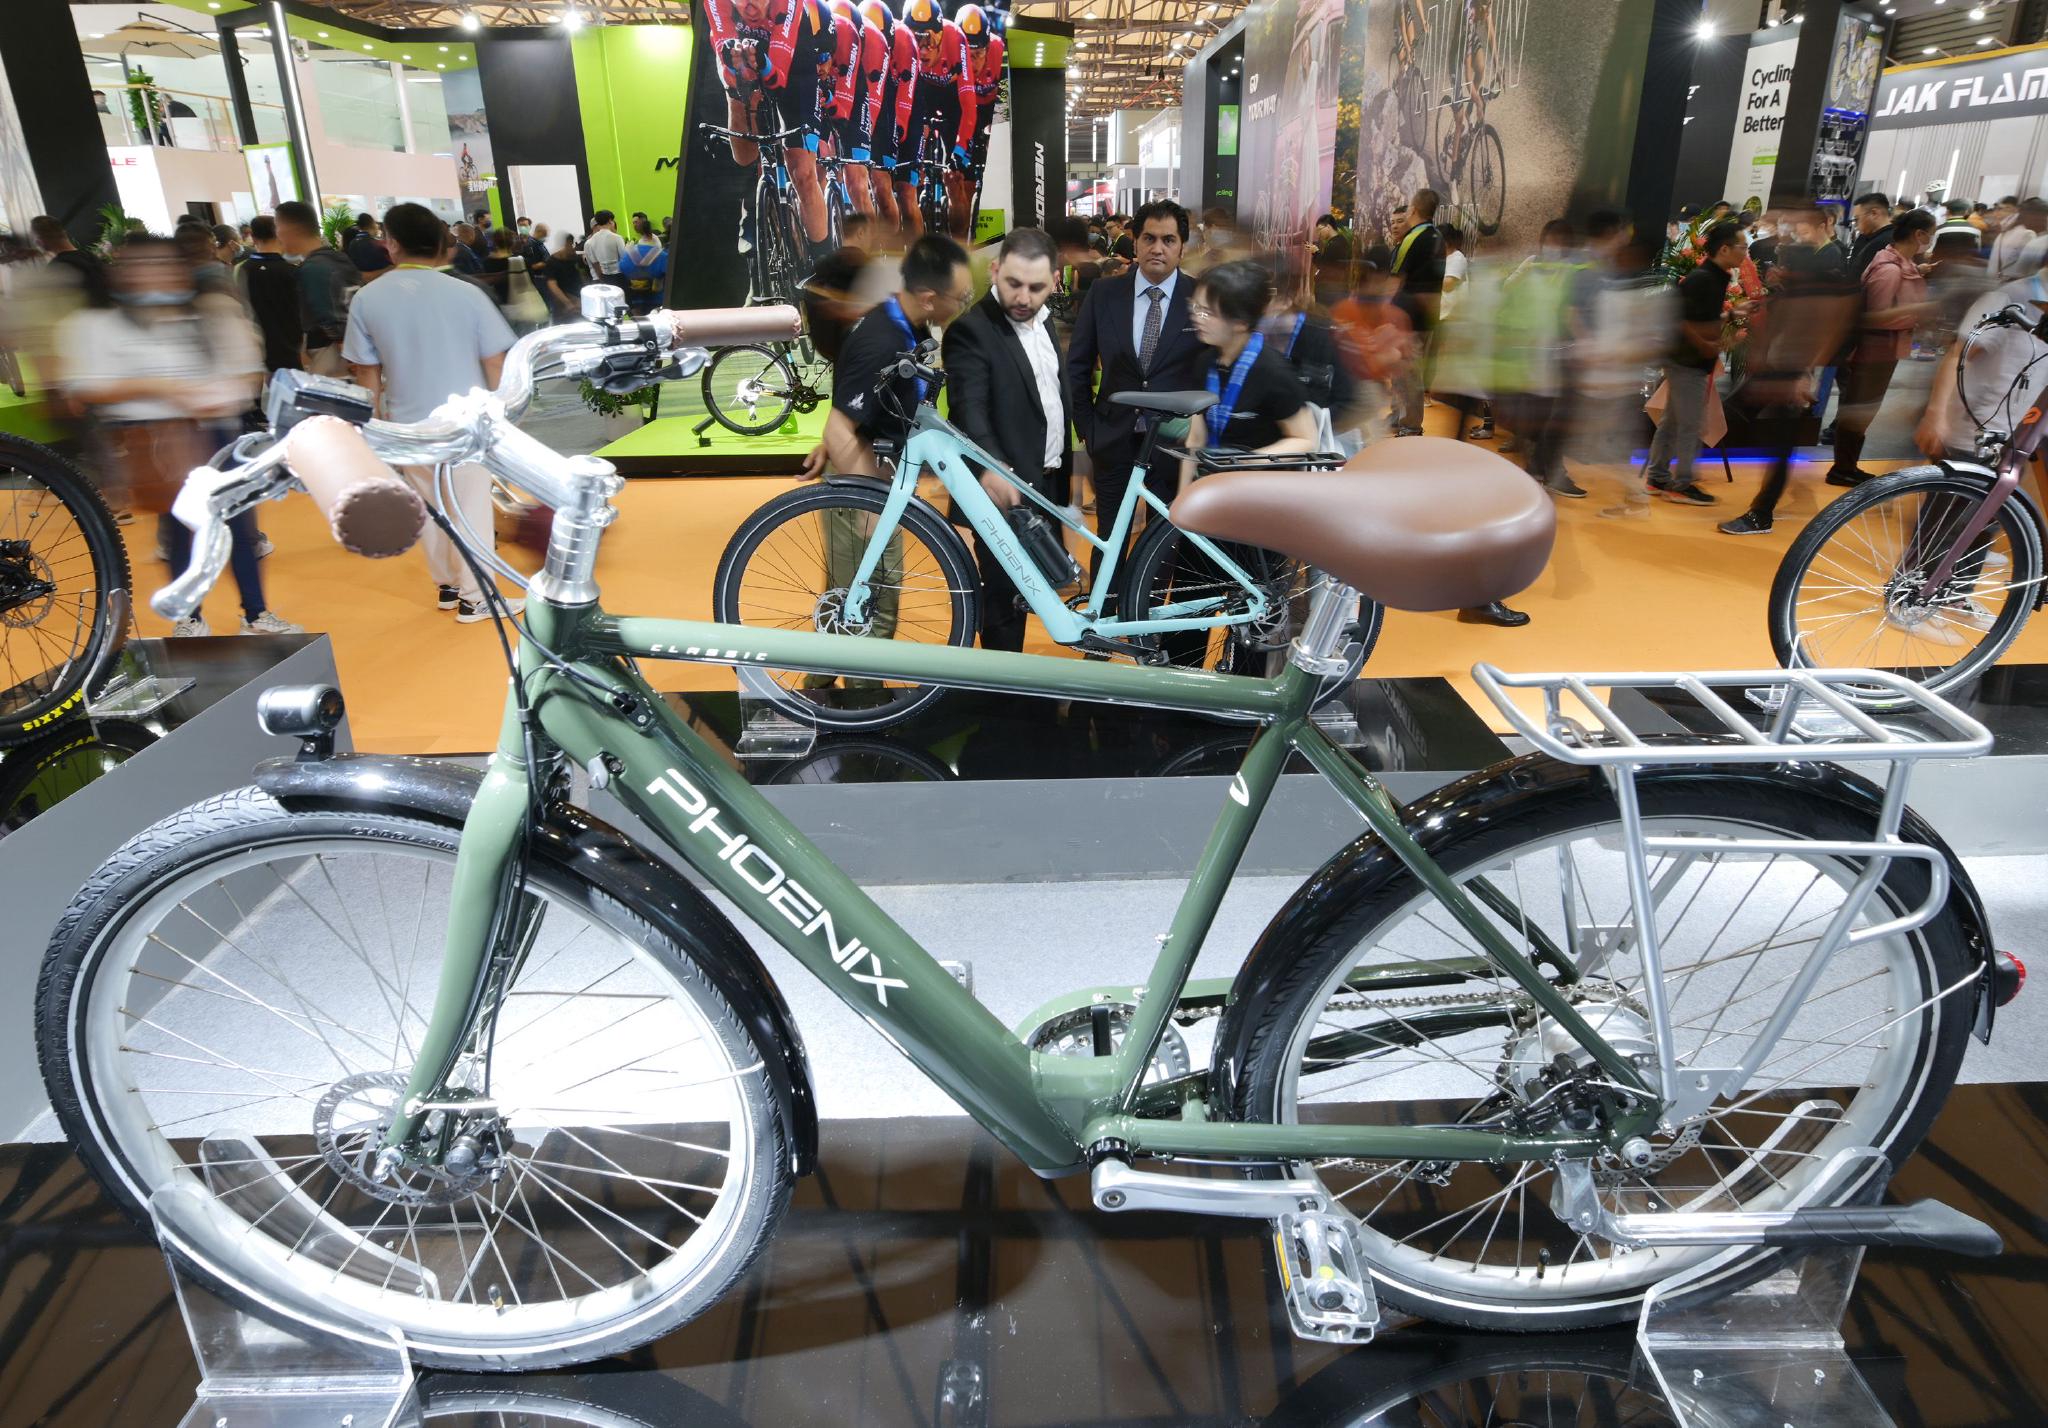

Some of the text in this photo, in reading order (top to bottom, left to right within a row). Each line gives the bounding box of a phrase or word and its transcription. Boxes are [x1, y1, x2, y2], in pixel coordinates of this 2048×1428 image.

[845, 43, 858, 89] MERIDA
[1752, 64, 1794, 89] Cyclin
[1747, 89, 1780, 110] For A
[1875, 81, 1947, 117] JAK
[1743, 114, 1784, 133] Better
[981, 517, 1041, 597] PHOENIX
[650, 644, 768, 660] CLASSIC
[22, 687, 83, 731] MAXXIS
[646, 768, 909, 1008] PHOENIX
